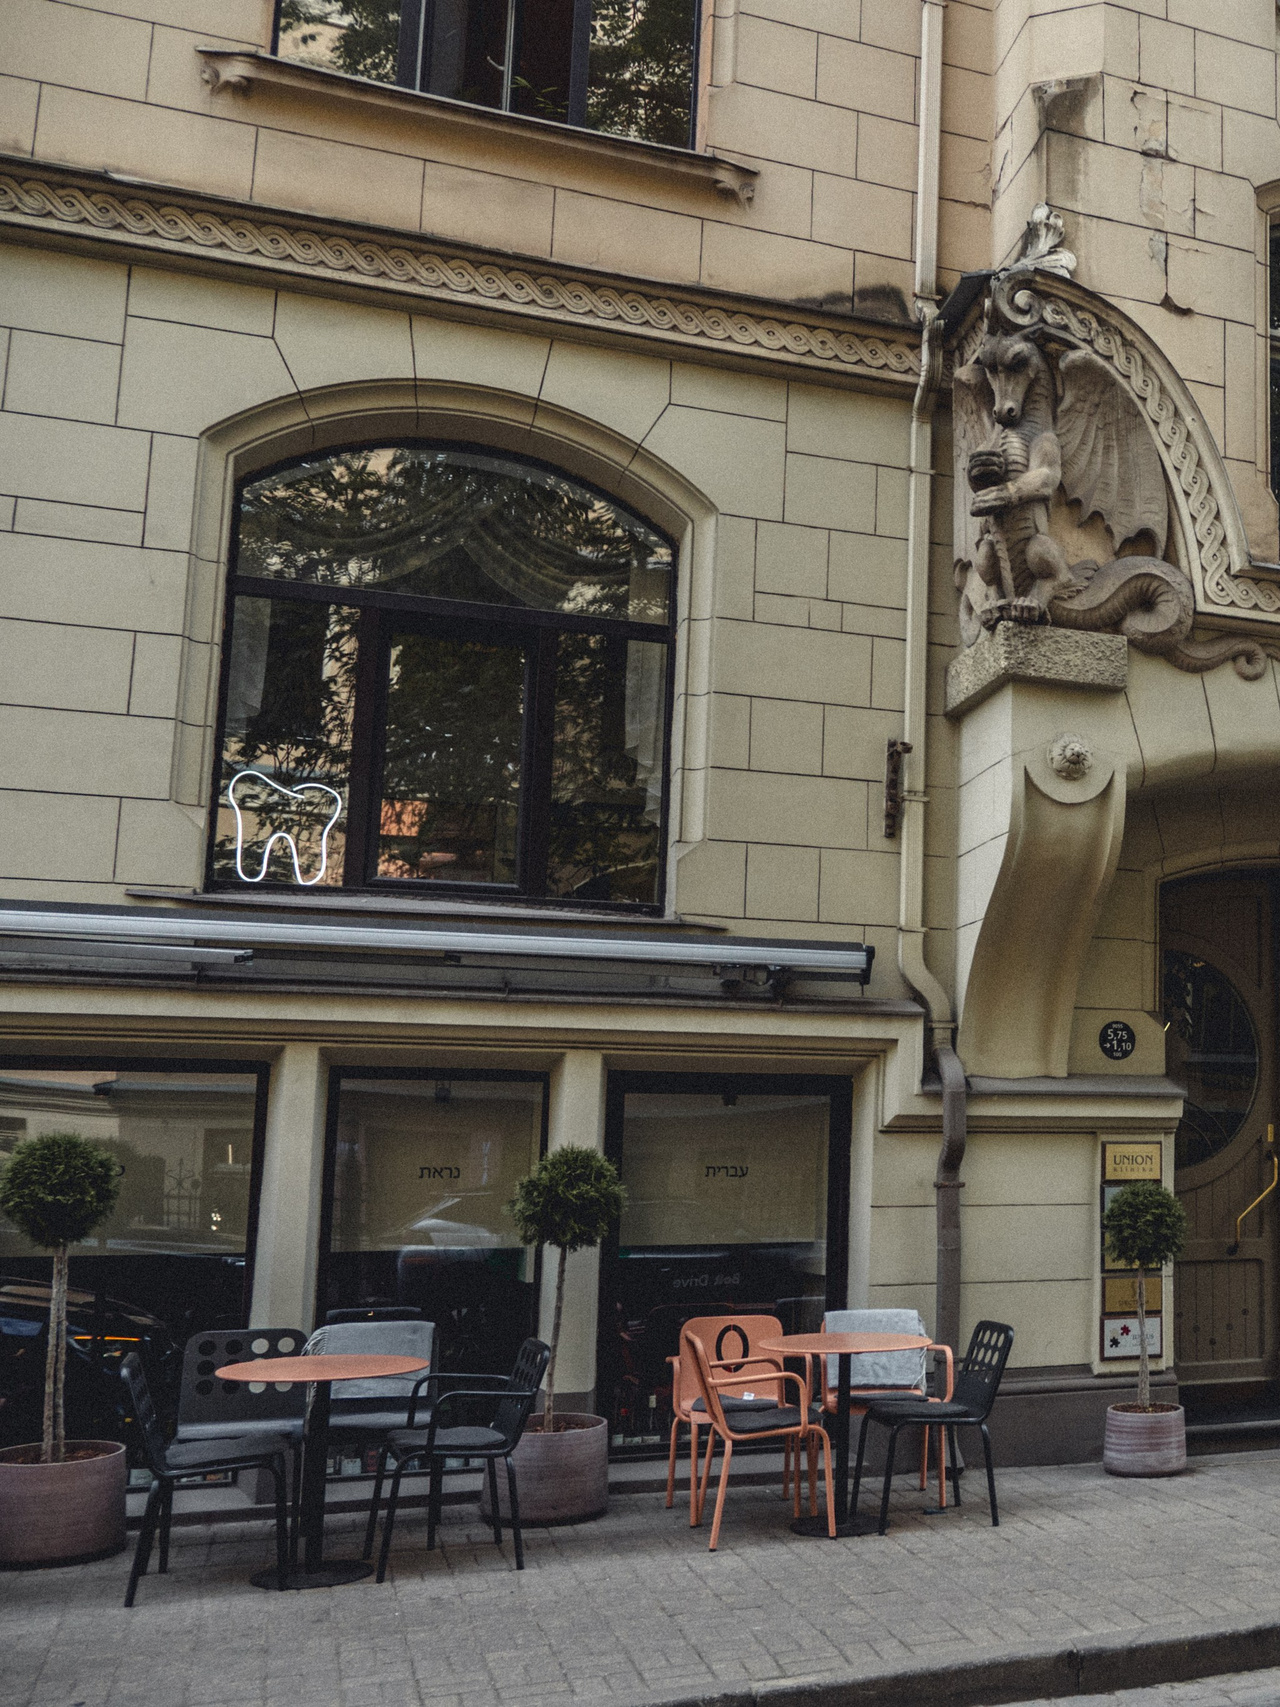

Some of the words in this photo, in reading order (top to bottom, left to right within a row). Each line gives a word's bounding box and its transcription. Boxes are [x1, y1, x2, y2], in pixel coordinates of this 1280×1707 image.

[1107, 1029, 1128, 1040] 5,75
[1113, 1154, 1154, 1165] UNION
[705, 1165, 749, 1178] עברית
